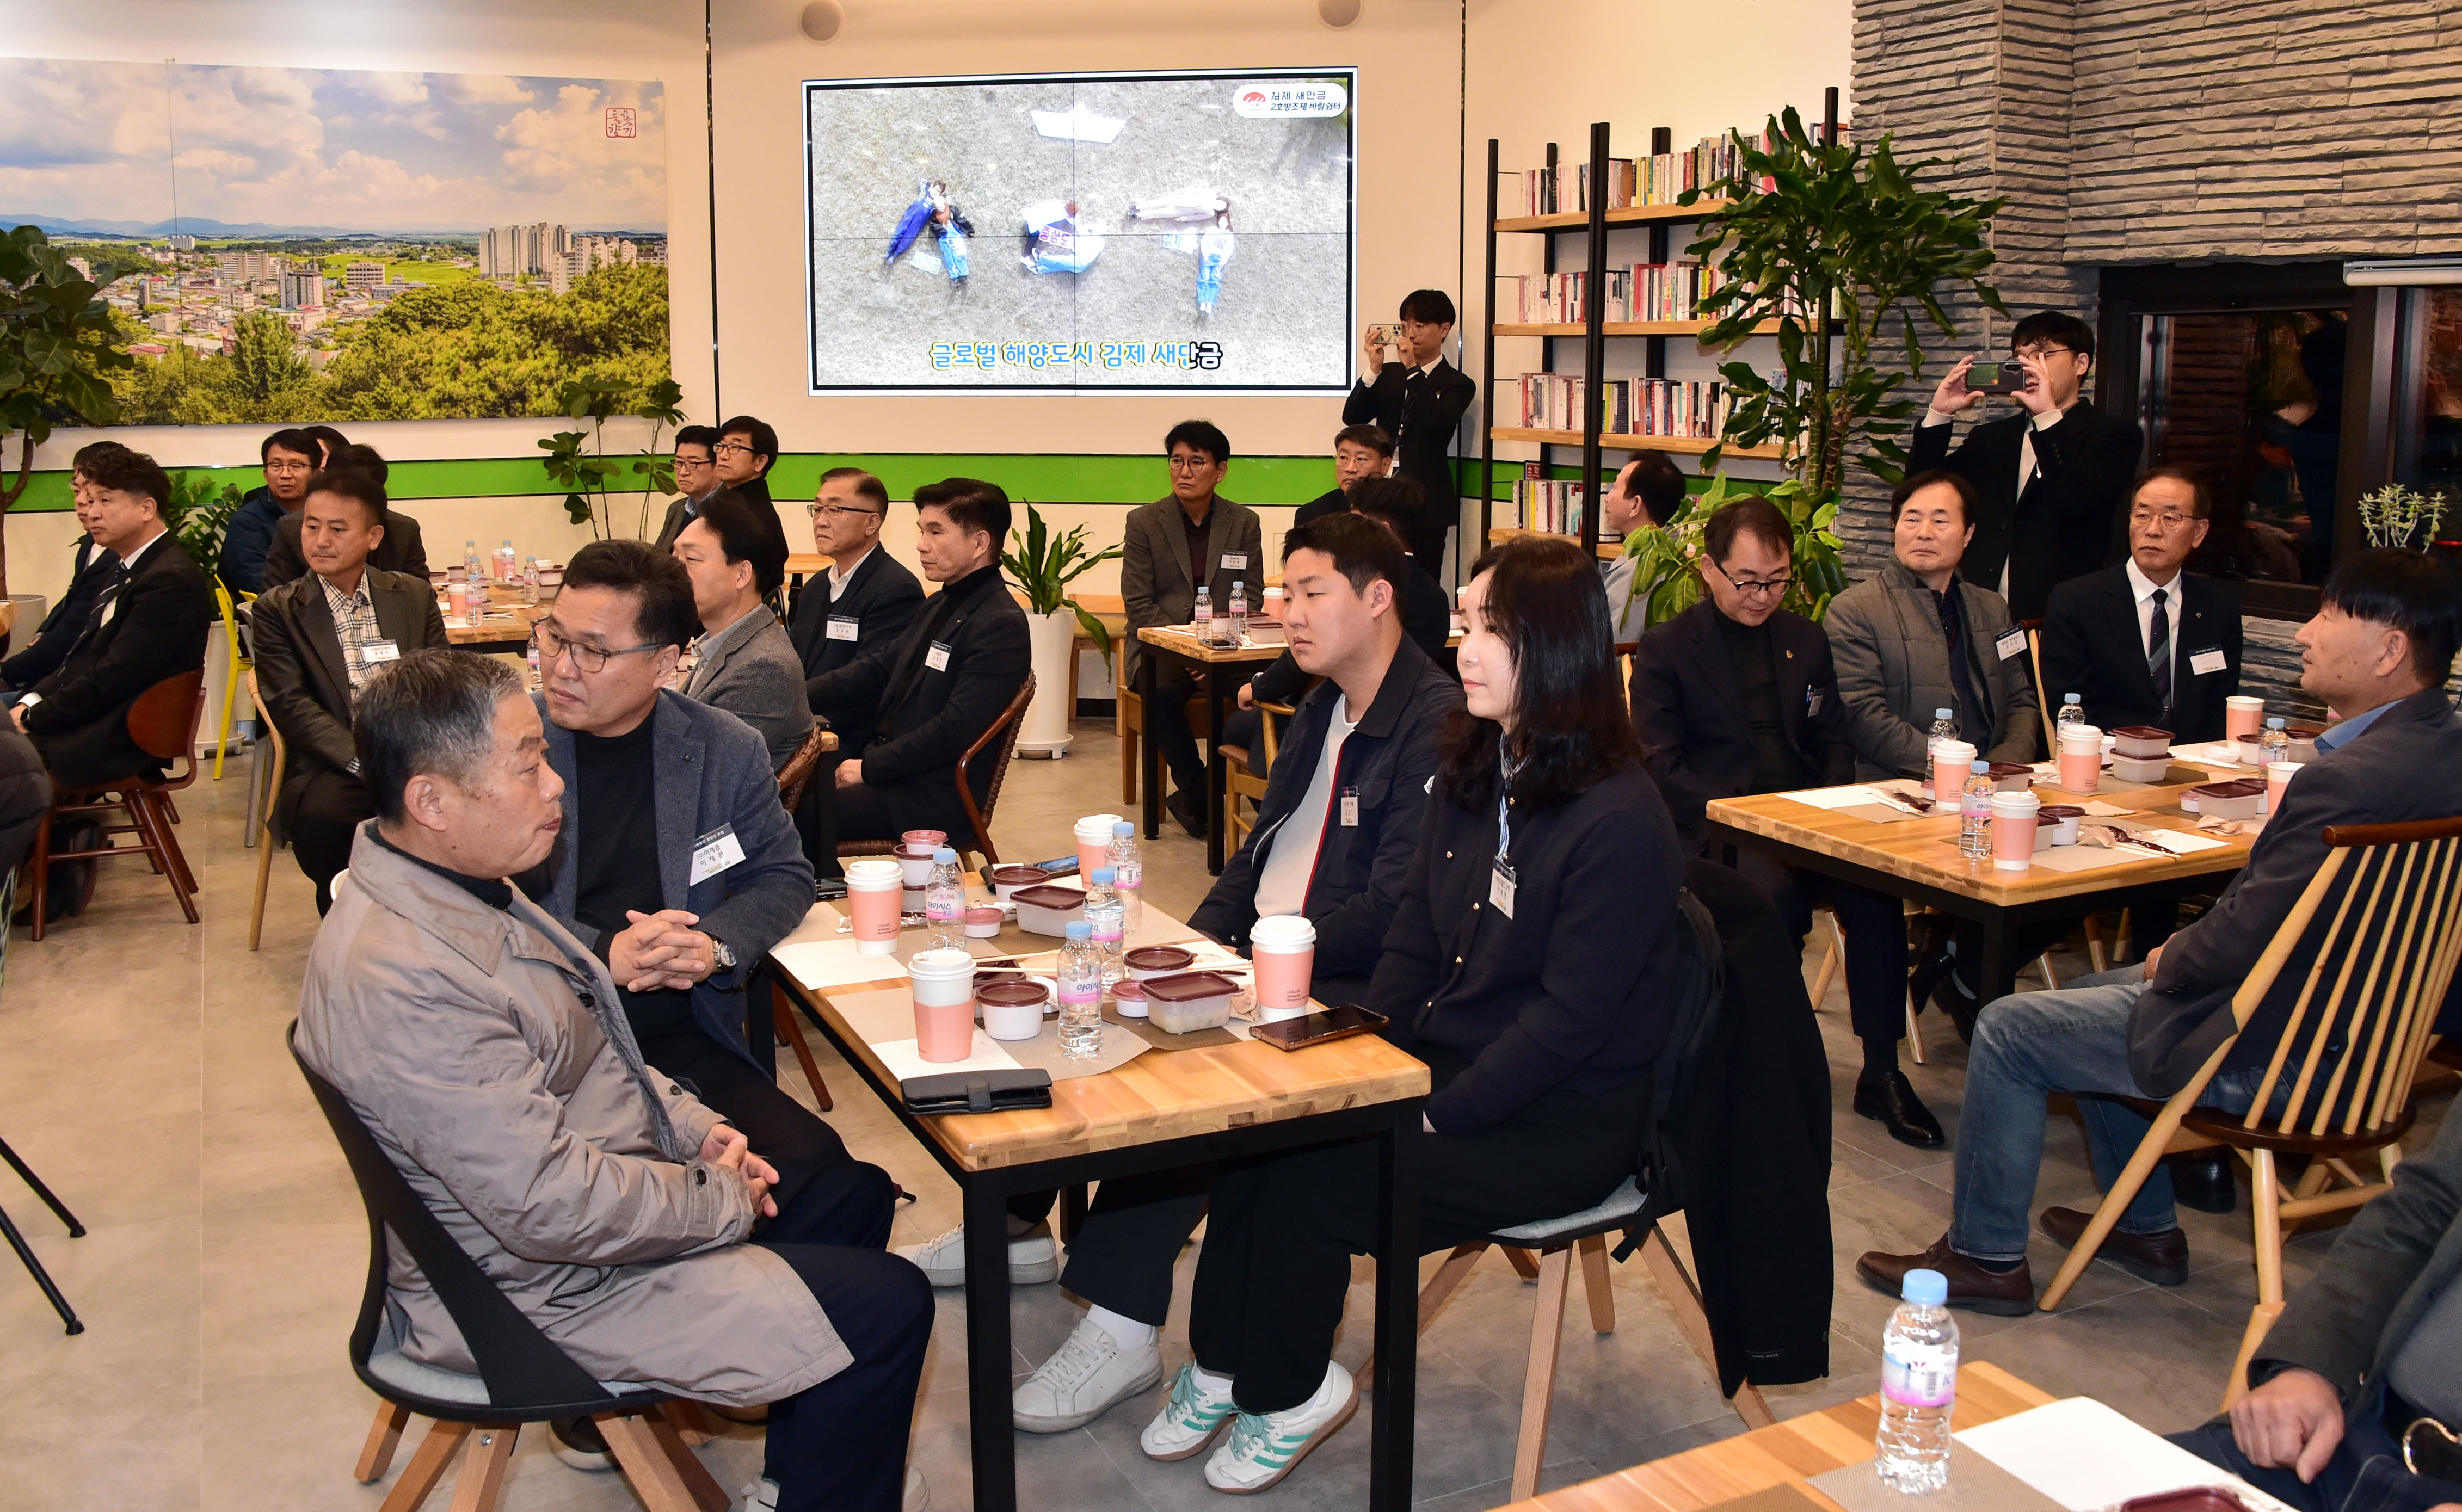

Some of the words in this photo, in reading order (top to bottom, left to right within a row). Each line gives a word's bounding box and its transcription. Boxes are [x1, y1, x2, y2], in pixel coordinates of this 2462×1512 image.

[1295, 91, 1326, 100] 새만금
[931, 343, 997, 369] 글로벌
[1005, 343, 1093, 368] 해양도시
[1103, 343, 1146, 369] 김제
[1154, 342, 1222, 369] 새만금
